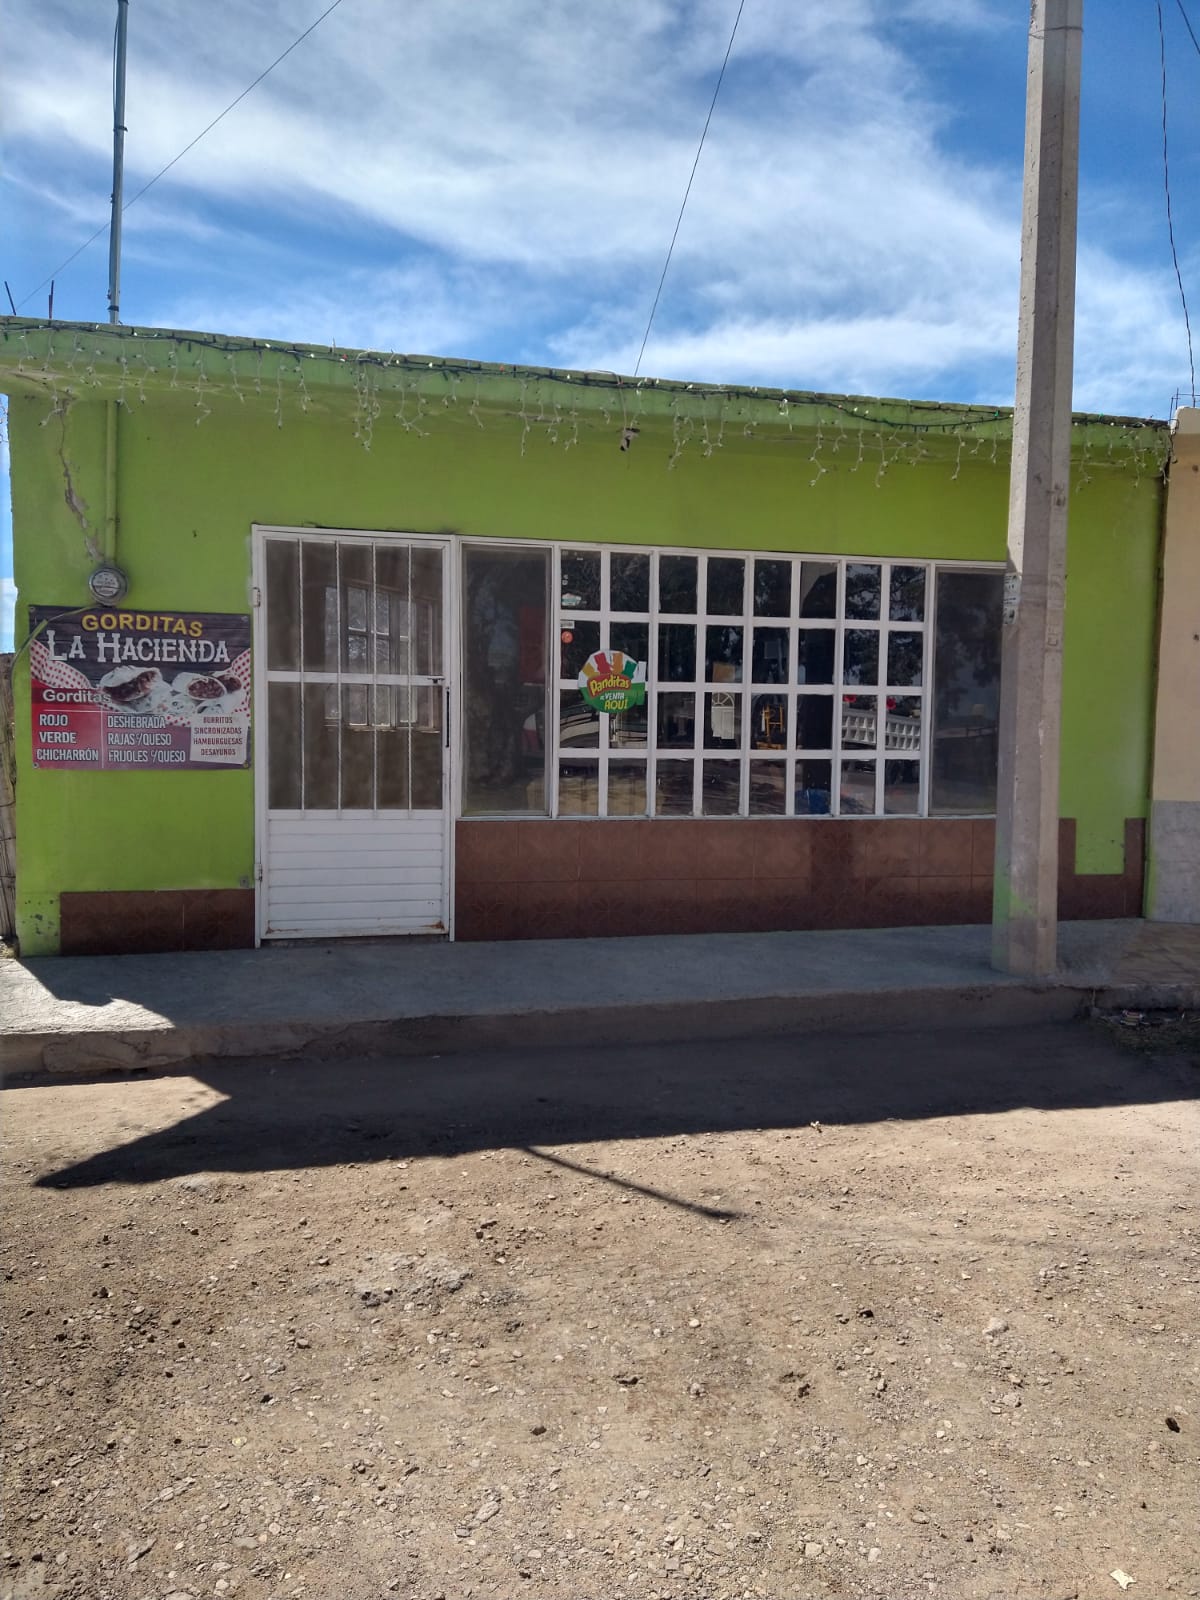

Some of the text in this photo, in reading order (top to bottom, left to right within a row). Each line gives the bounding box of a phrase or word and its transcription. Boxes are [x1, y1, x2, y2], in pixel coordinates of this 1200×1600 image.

[82, 613, 203, 637] GORDITAS
[46, 630, 230, 663] LA HACIENDA
[590, 675, 629, 696] Panditas
[43, 689, 112, 703] Gorditas
[39, 714, 69, 726] ROJO
[107, 716, 166, 729] DESHEBRADA
[39, 731, 77, 744] VERDE
[194, 727, 242, 735] SINCRONIZADAS
[108, 733, 135, 745] RAJAS
[193, 737, 243, 745] HAMBURGUESAS
[36, 748, 99, 761] CHICHARRÓN
[108, 750, 148, 762] FRIJOLES
[200, 748, 236, 756] DESAYUNOS
